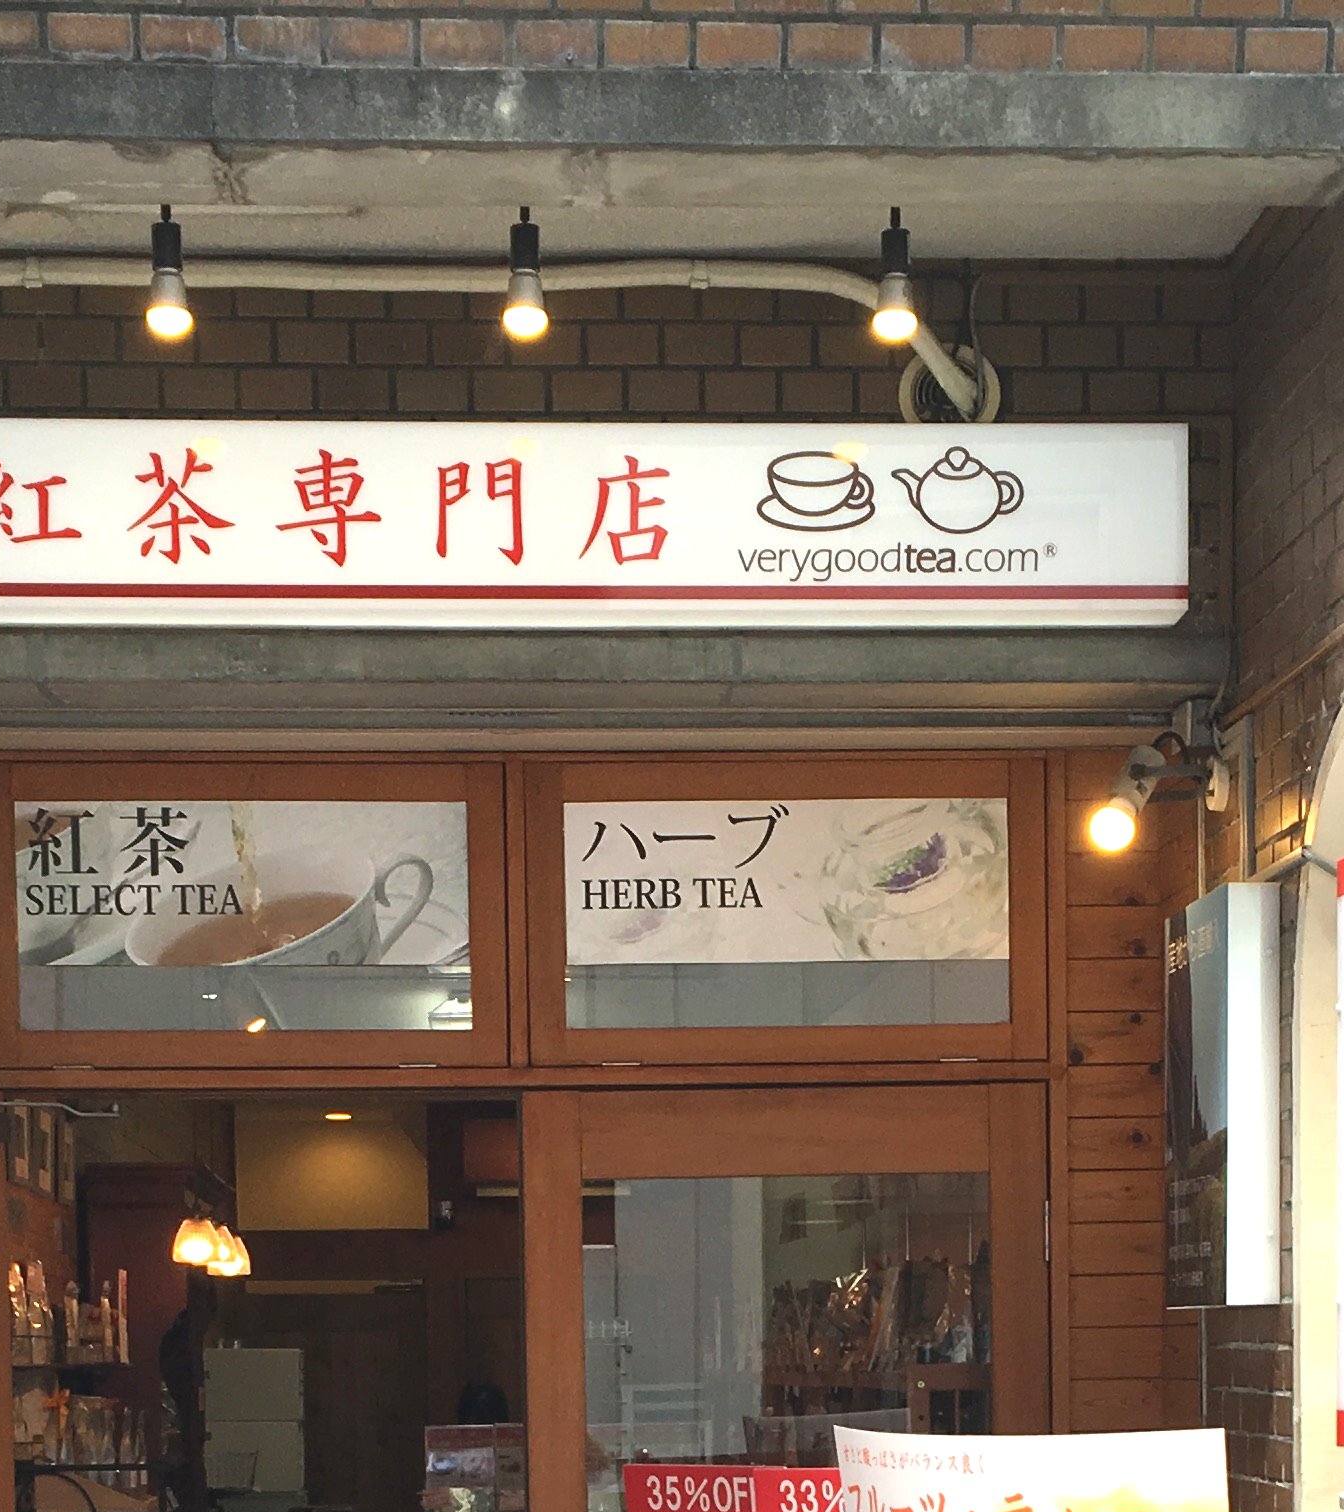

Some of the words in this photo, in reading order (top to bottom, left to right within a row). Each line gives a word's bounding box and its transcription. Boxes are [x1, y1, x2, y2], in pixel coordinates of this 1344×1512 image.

[25, 806, 190, 878] 紅茶
[581, 804, 788, 869] ハーブ
[25, 883, 165, 918] SELECT
[173, 883, 244, 918] TEA
[582, 877, 681, 911] HERB
[692, 877, 764, 911] TEA
